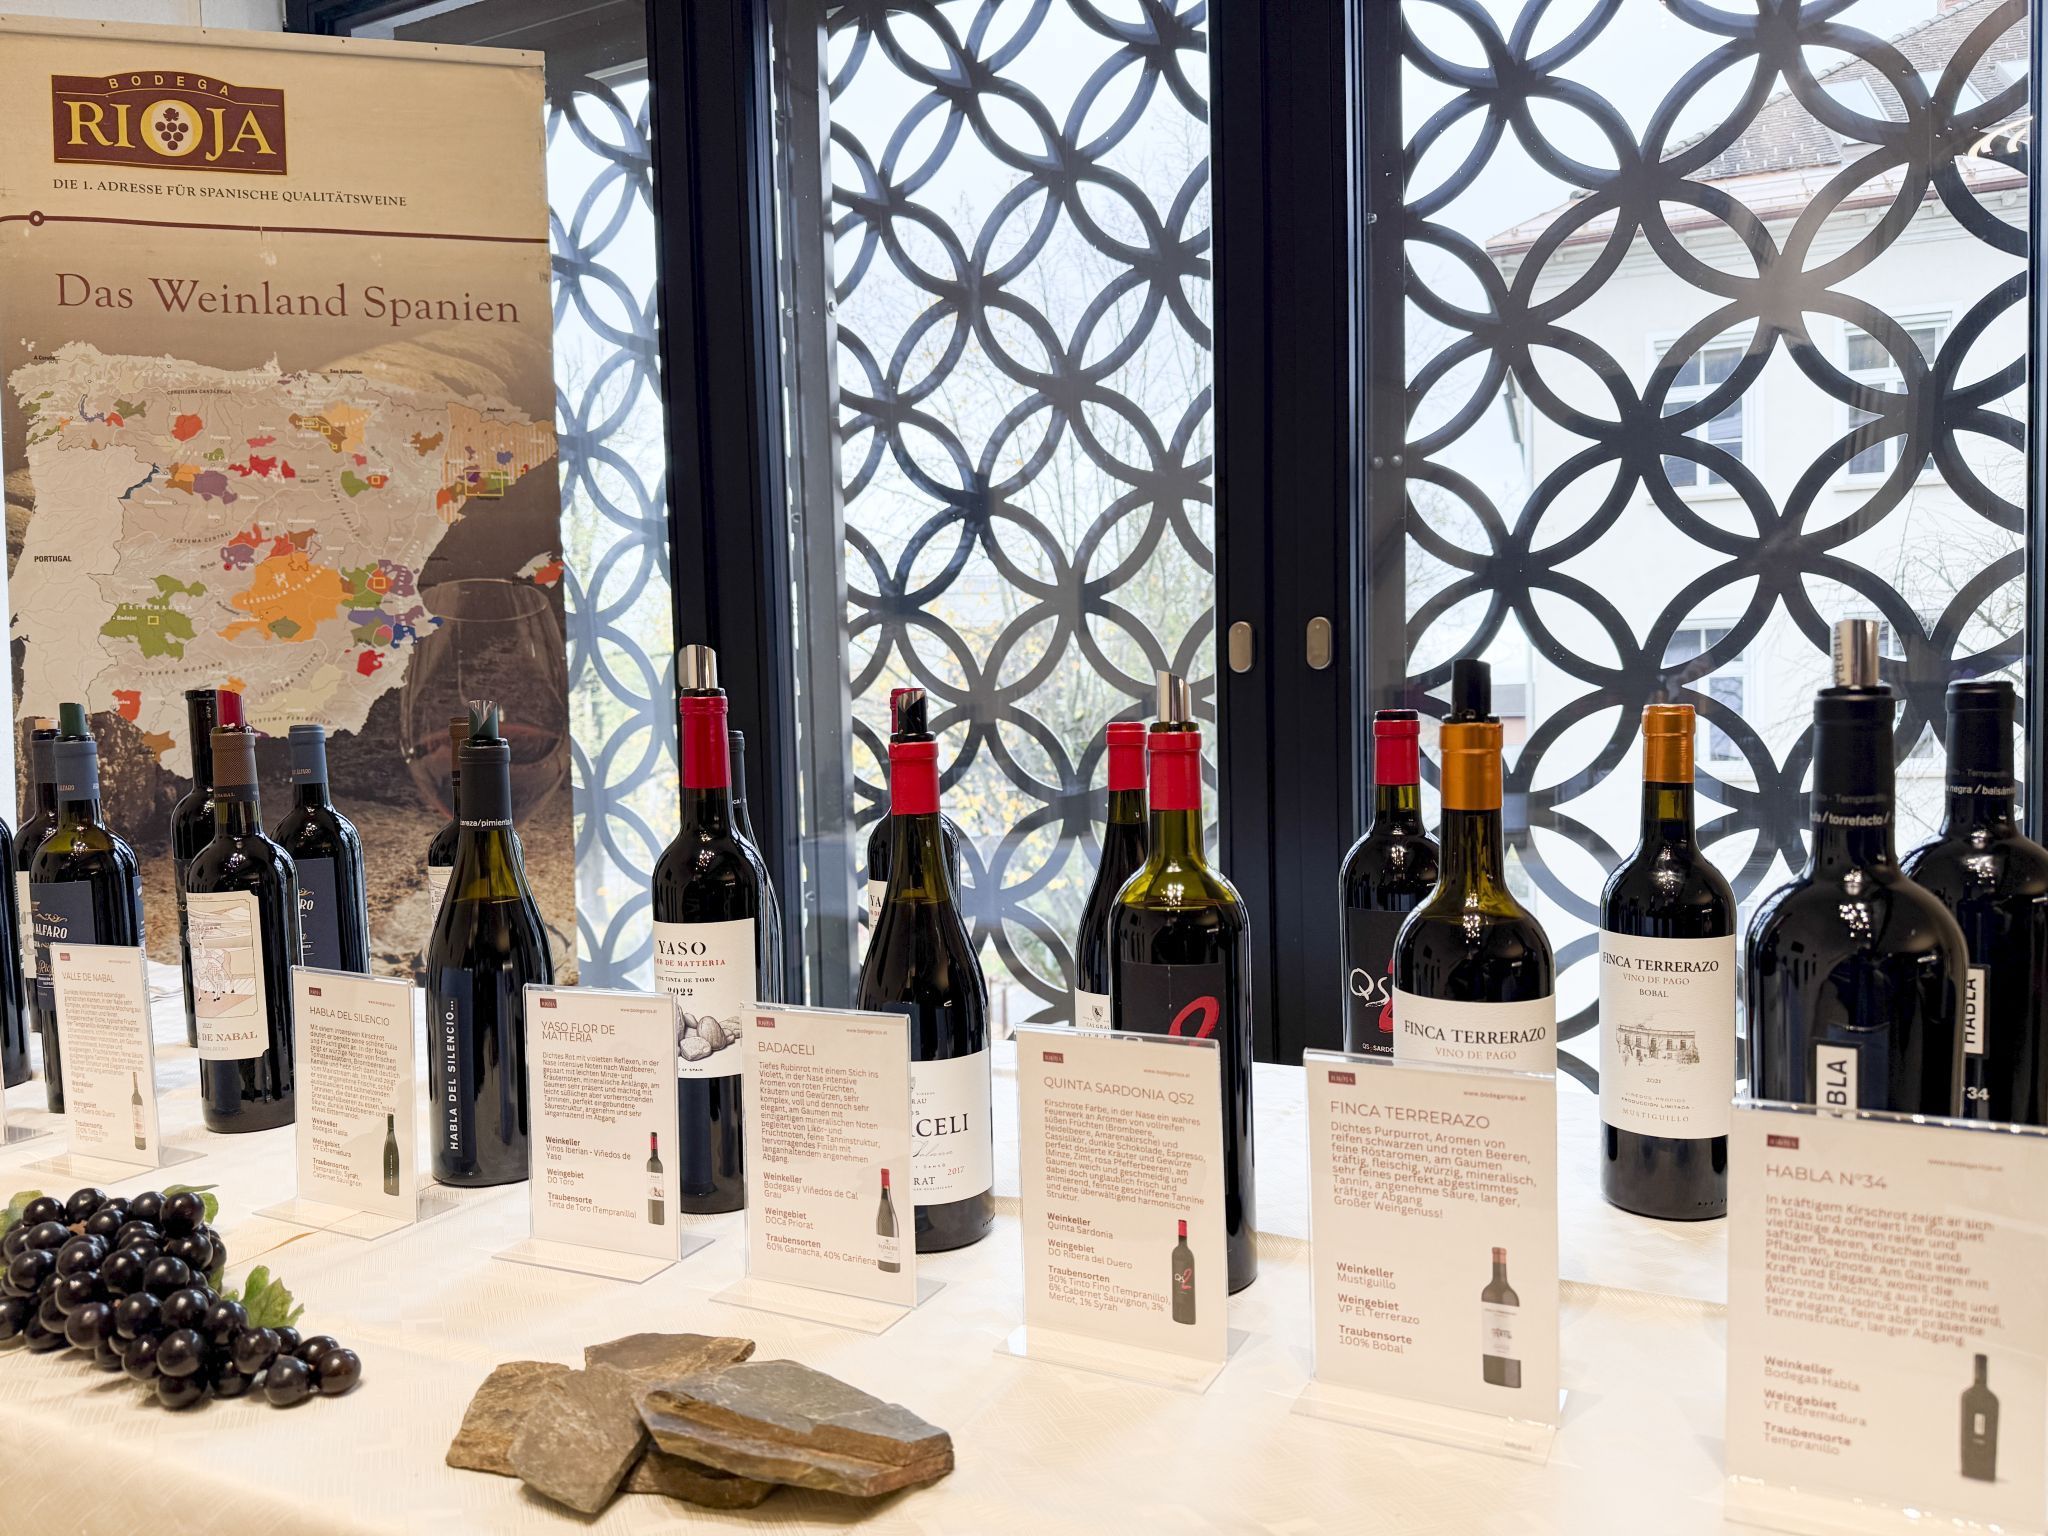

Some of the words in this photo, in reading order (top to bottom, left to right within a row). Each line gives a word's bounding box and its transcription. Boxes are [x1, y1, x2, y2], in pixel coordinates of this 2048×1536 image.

[109, 74, 230, 96] BODEGA
[62, 99, 277, 162] RIOJA
[53, 179, 78, 190] DIE
[82, 180, 93, 190] 1.
[97, 181, 163, 195] ADRESSE
[167, 183, 196, 197] FÜR
[200, 186, 279, 200] SPANISCHE
[282, 189, 407, 207] QUALITÄTSWEINE
[55, 273, 133, 308] Das
[148, 277, 347, 318] Weinland
[365, 287, 521, 326] Spanien
[658, 940, 706, 955] YASO
[677, 959, 726, 967] MATTERIA
[1602, 951, 1631, 969] FINCA
[1635, 959, 1719, 973] TERRERAZO
[61, 972, 81, 981] VALLE
[82, 973, 92, 981] DE
[92, 974, 115, 983] NABAL
[1622, 973, 1646, 984] VINO
[1647, 976, 1660, 984] DE
[1663, 977, 1690, 986] PAGO
[1639, 988, 1669, 998] BOBAL
[309, 1006, 335, 1018] HABLA
[337, 1010, 352, 1020] DEL
[353, 1012, 390, 1026] SILENCIO
[202, 1033, 213, 1042] DE
[216, 1031, 258, 1042] NABAL
[541, 1021, 568, 1032] YASO
[571, 1022, 598, 1033] FLOR
[601, 1024, 615, 1034] DE
[542, 1030, 592, 1042] MATTERIA
[1404, 1019, 1445, 1041] FINCA
[1451, 1026, 1546, 1045] TERRERAZO
[758, 1041, 815, 1055] BADACELI
[1435, 1047, 1465, 1058] VINO
[1469, 1049, 1483, 1059] DE
[1486, 1050, 1516, 1060] PAGO
[448, 1078, 457, 1101] DEL
[1043, 1076, 1092, 1092] QUINTA
[1095, 1082, 1165, 1101] SARDONIA
[1168, 1091, 1194, 1105] QS2
[1330, 1100, 1381, 1118] FINCA
[1384, 1106, 1490, 1129] TERRERAZO
[1622, 1109, 1689, 1122] MUSTIGUILLO
[449, 1107, 459, 1150] HABLA
[1330, 1121, 1372, 1135] Dichtes
[1374, 1126, 1432, 1143] Purpurrot,
[1435, 1132, 1480, 1147] Aromen
[1483, 1140, 1505, 1149] von
[545, 1136, 580, 1146] Weinkeller
[1331, 1132, 1362, 1144] reifen
[1365, 1136, 1423, 1151] schwarzen
[1426, 1142, 1447, 1154] und
[1451, 1145, 1482, 1157] roten
[1486, 1148, 1530, 1163] Beeren,
[546, 1144, 564, 1153] Vinos
[622, 1152, 631, 1160] de
[546, 1152, 562, 1160] Yaso
[547, 1168, 584, 1178] Weingebiet
[763, 1172, 802, 1183] Weinkeller
[947, 1165, 965, 1176] 2017
[1766, 1163, 1834, 1183] HABLA
[547, 1176, 557, 1184] DO
[559, 1177, 574, 1186] Toro
[764, 1181, 795, 1192] Bodegas
[803, 1186, 832, 1196] Viñedos
[834, 1189, 844, 1198] de
[548, 1192, 593, 1204] Traubensorte
[764, 1189, 781, 1199] Grau
[548, 1200, 565, 1209] Tinta
[565, 1202, 574, 1210] de
[576, 1203, 591, 1212] Toro
[764, 1207, 807, 1219] Weingebiet
[765, 1216, 786, 1226] DOCa
[788, 1219, 813, 1229] Priorat
[1047, 1212, 1090, 1226] Weinkeller
[1048, 1221, 1075, 1233] Quinta
[1076, 1226, 1113, 1239] Sardonia
[766, 1233, 821, 1248] Traubensorten
[1047, 1238, 1094, 1253] Weingebiet
[766, 1242, 782, 1251] 60%
[785, 1245, 821, 1258] Garnacha,
[823, 1250, 840, 1260] 40%
[842, 1253, 876, 1265] Cariñena
[1048, 1247, 1061, 1256] DO
[1063, 1250, 1088, 1261] Ribera
[1091, 1255, 1104, 1264] del
[1107, 1258, 1133, 1269] Duero
[1048, 1265, 1110, 1283] Traubensorten
[1336, 1261, 1394, 1279] Weinkeller
[1069, 1278, 1090, 1288] Tinto
[1092, 1282, 1110, 1292] Fino
[1337, 1272, 1396, 1290] Mustiguillo
[1049, 1283, 1061, 1292] 6%
[1063, 1285, 1101, 1299] Cabernet
[1103, 1293, 1150, 1310] Sauvignon,
[1151, 1302, 1164, 1311] 3%
[1049, 1292, 1077, 1304] Merlot,
[1079, 1298, 1092, 1307] 1%
[1094, 1300, 1118, 1312] Syrah
[1337, 1293, 1399, 1311] Weingebiet
[1338, 1303, 1353, 1314] VP
[1355, 1306, 1365, 1316] El
[1368, 1308, 1420, 1325] Terrerazo
[1339, 1324, 1412, 1345] Traubensorte
[1339, 1335, 1370, 1348] 100%
[1372, 1340, 1404, 1354] Bobal
[1764, 1356, 1833, 1375] Weinkeller
[1764, 1367, 1818, 1384] Bodegas
[1822, 1376, 1860, 1391] Habla
[1764, 1389, 1837, 1410] Weingebiet
[1764, 1400, 1780, 1411] VT
[1784, 1403, 1867, 1426] Extremadura
[1764, 1422, 1851, 1446] Traubensorte
[1764, 1433, 1840, 1455] Tempranillo
